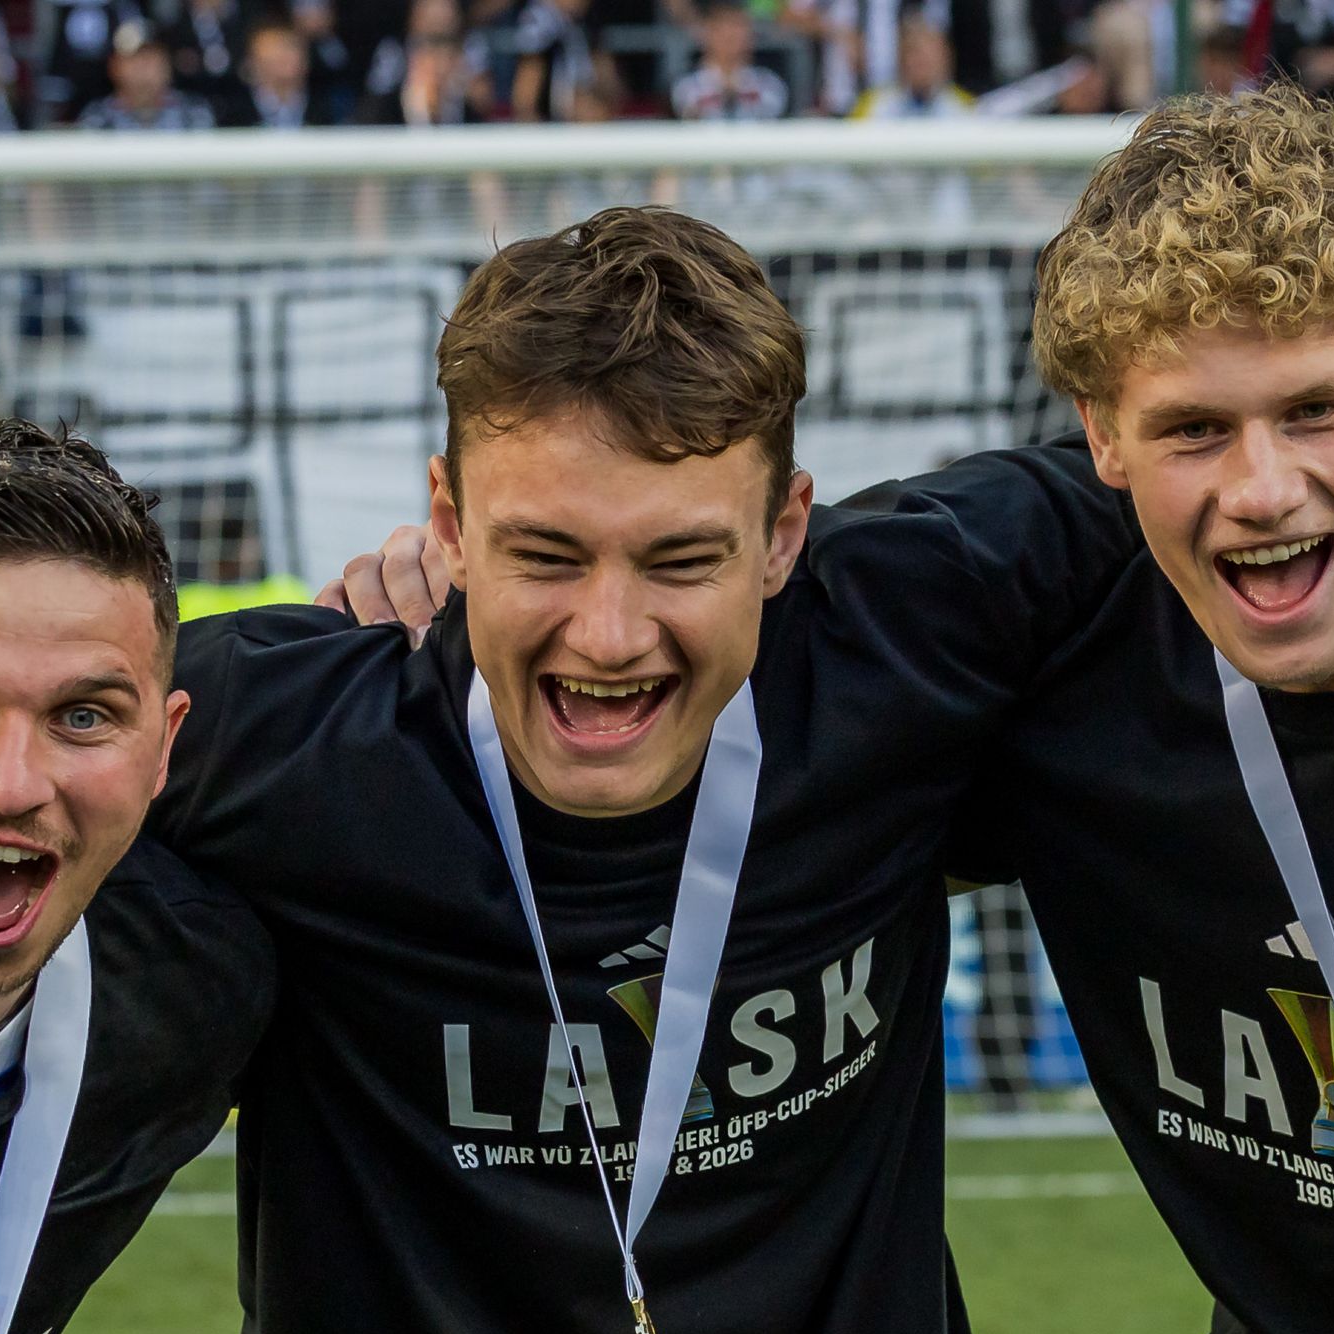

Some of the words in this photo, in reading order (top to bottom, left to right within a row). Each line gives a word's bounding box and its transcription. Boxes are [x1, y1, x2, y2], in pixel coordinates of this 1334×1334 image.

[443, 937, 880, 1133] LASK
[452, 1142, 479, 1169] ES
[484, 1145, 535, 1167] WAR
[541, 1145, 573, 1166] VÜ
[727, 1040, 878, 1139] ÖFB-CUP-SIEGER
[1157, 1109, 1183, 1138] ES
[1187, 1117, 1229, 1152] WAR
[1233, 1134, 1261, 1161] VÜ
[1264, 1145, 1334, 1185] Z'LANG
[675, 1155, 694, 1176] &
[699, 1138, 755, 1171] 2026
